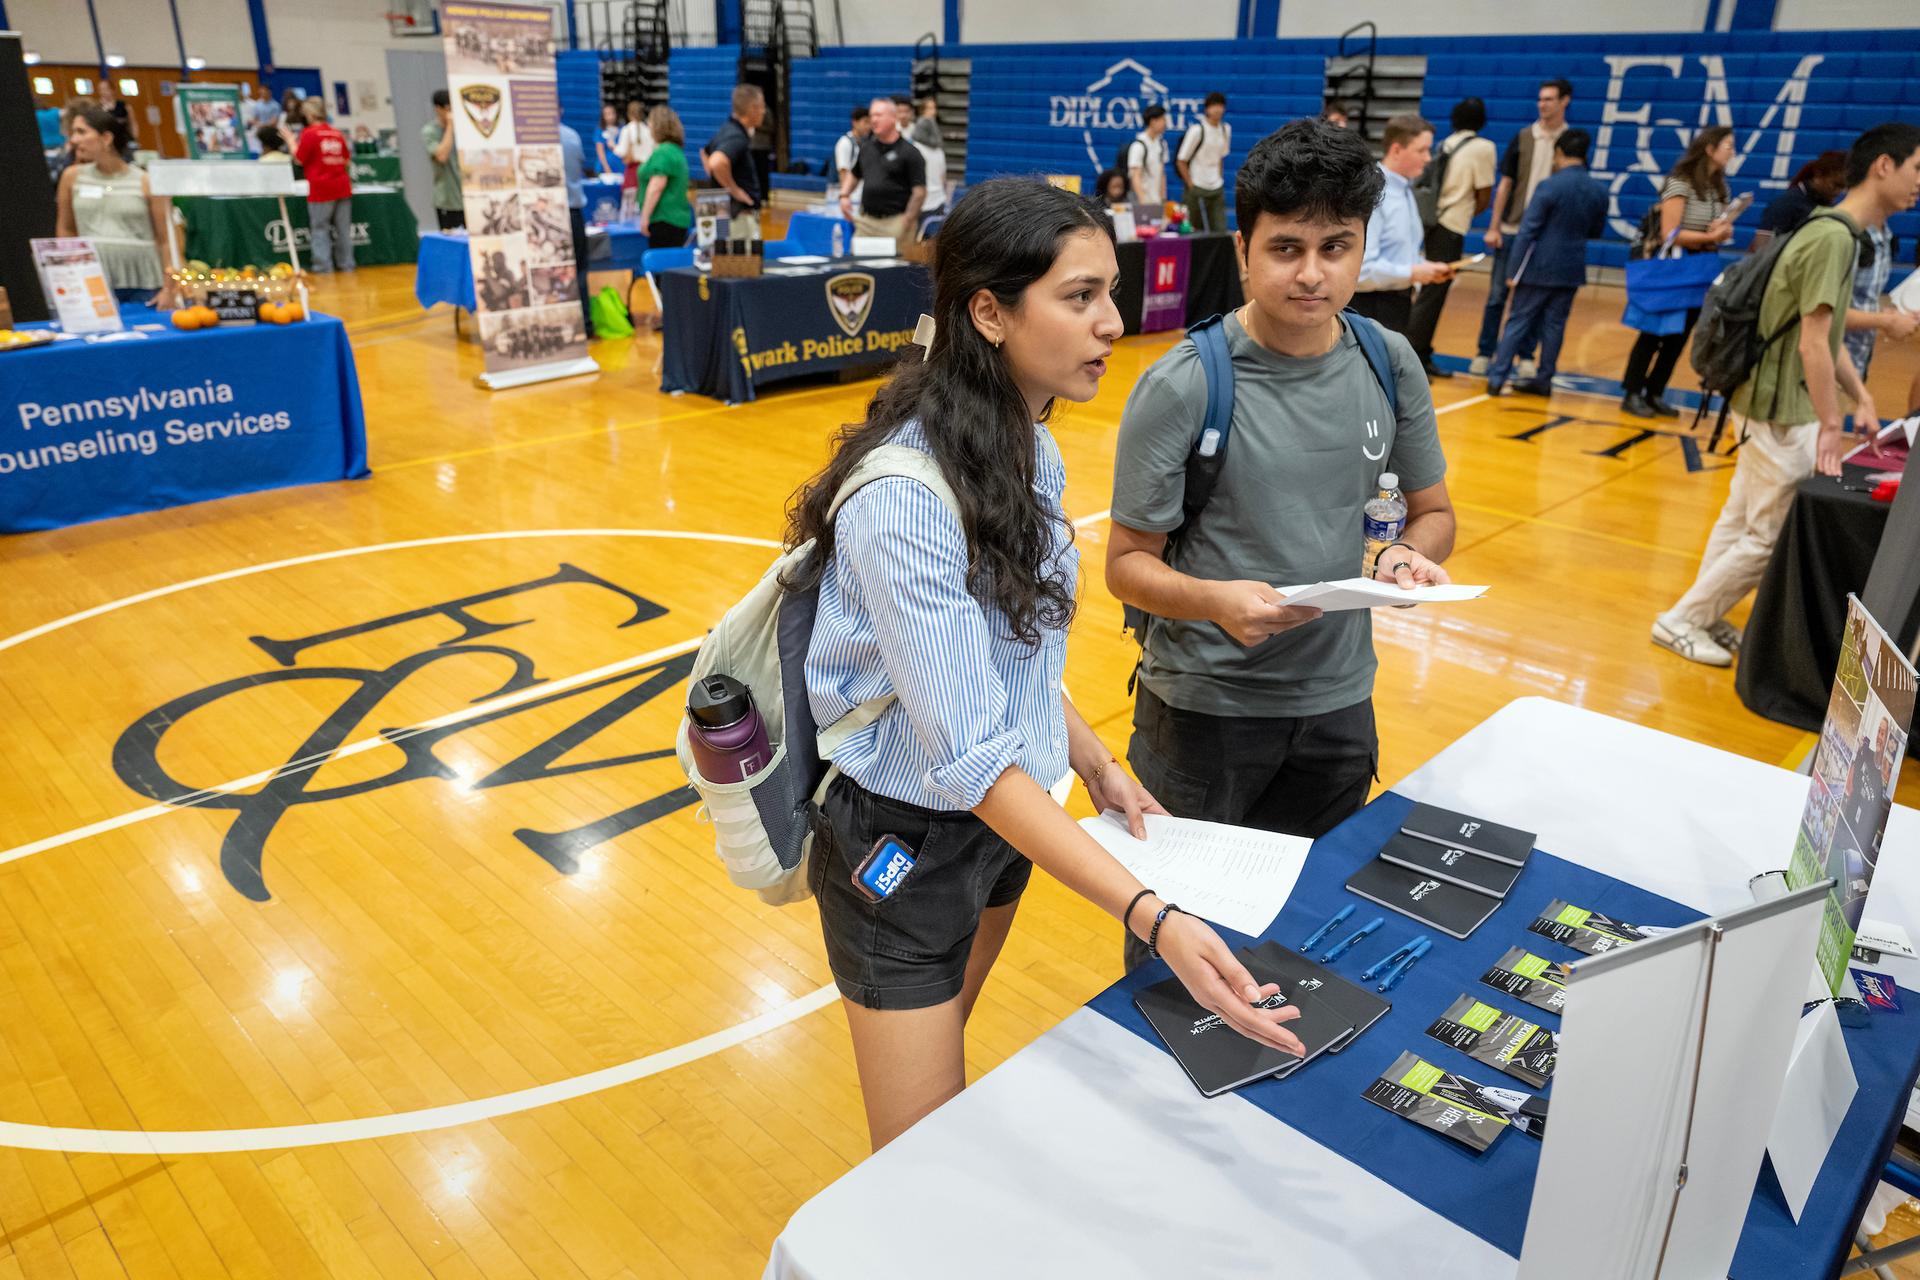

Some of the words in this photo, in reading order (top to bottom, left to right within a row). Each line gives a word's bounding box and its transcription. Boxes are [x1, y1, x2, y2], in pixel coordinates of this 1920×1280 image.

[802, 335, 863, 361] Police
[18, 379, 234, 430] Pennsylvania
[0, 429, 158, 474] ounseling
[164, 411, 291, 445] Services
[874, 852, 907, 891] DIPS!
[1435, 1106, 1465, 1128] HERE
